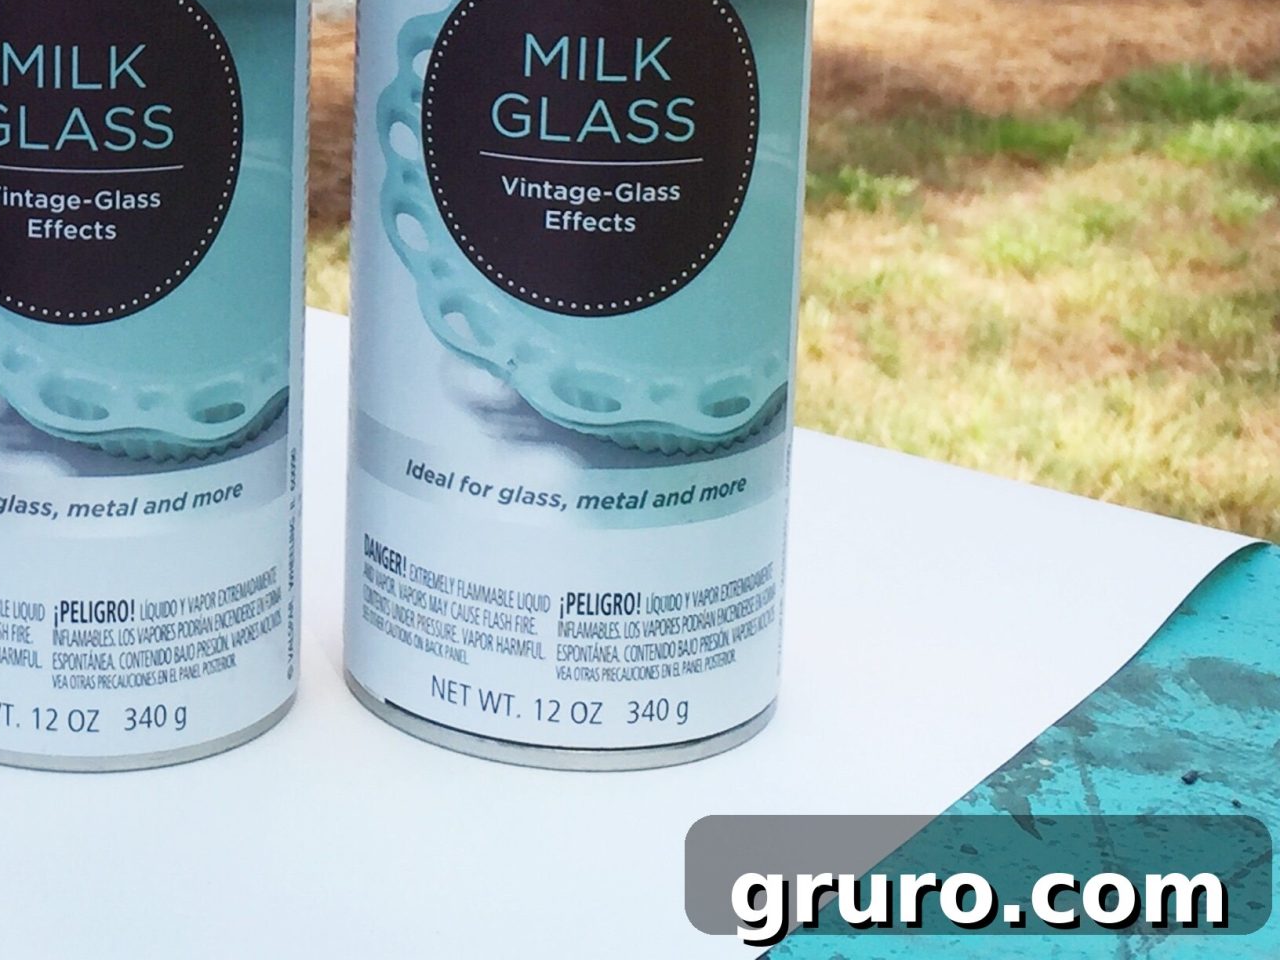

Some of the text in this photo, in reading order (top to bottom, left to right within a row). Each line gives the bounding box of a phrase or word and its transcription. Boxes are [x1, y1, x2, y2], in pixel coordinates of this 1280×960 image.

[2, 42, 146, 90] MILK
[524, 33, 672, 81] MILK
[492, 92, 696, 144] GLASS
[501, 176, 681, 205] Vintage-Glass
[28, 219, 117, 240] Effects
[545, 210, 636, 232] Effects
[406, 459, 747, 511] Ideal for glass, metal and more
[67, 493, 137, 518] metal
[143, 492, 186, 514] and
[193, 481, 243, 510] more
[364, 533, 550, 614] DANGER! EXTREMELY FLAMMABLE LIQUID
[13, 601, 45, 622] LIQUID
[54, 592, 216, 627] ¡PELIGRO! LÍQUIDO Y VAPOR
[429, 595, 538, 635] MAY CAUSE FLASH FIRE.
[560, 586, 719, 618] ¡PELIGRO! LÍQUIDO Y VAPOR
[11, 625, 33, 644] FIRE.
[53, 629, 115, 648] INFLAMABLES.
[118, 629, 134, 646] LOS
[137, 622, 176, 644] VAPORES
[417, 613, 460, 643] PRESSURE.
[462, 627, 494, 651] VAPOR
[496, 635, 546, 660] HARMFUL.
[624, 620, 640, 638] LOS
[643, 615, 681, 637] VAPORES
[119, 647, 171, 670] CONTENIDO
[174, 642, 195, 664] BAJO
[425, 638, 443, 657] BACK
[624, 640, 676, 662] CONTENIDO
[678, 638, 698, 657] BAJO
[52, 675, 68, 689] VEA
[71, 675, 96, 689] OTRAS
[97, 668, 156, 689] PRECAUCIONES
[157, 669, 168, 683] EN
[179, 662, 200, 679] PANEL
[556, 666, 572, 680] VEA
[574, 666, 600, 681] OTRAS
[602, 663, 659, 681] PRECAUCIONES
[431, 674, 689, 724] NET WT. 12 OZ 340 g
[31, 707, 58, 731] 12
[67, 708, 100, 732] OZ
[124, 704, 167, 731] 340
[173, 705, 187, 729] g
